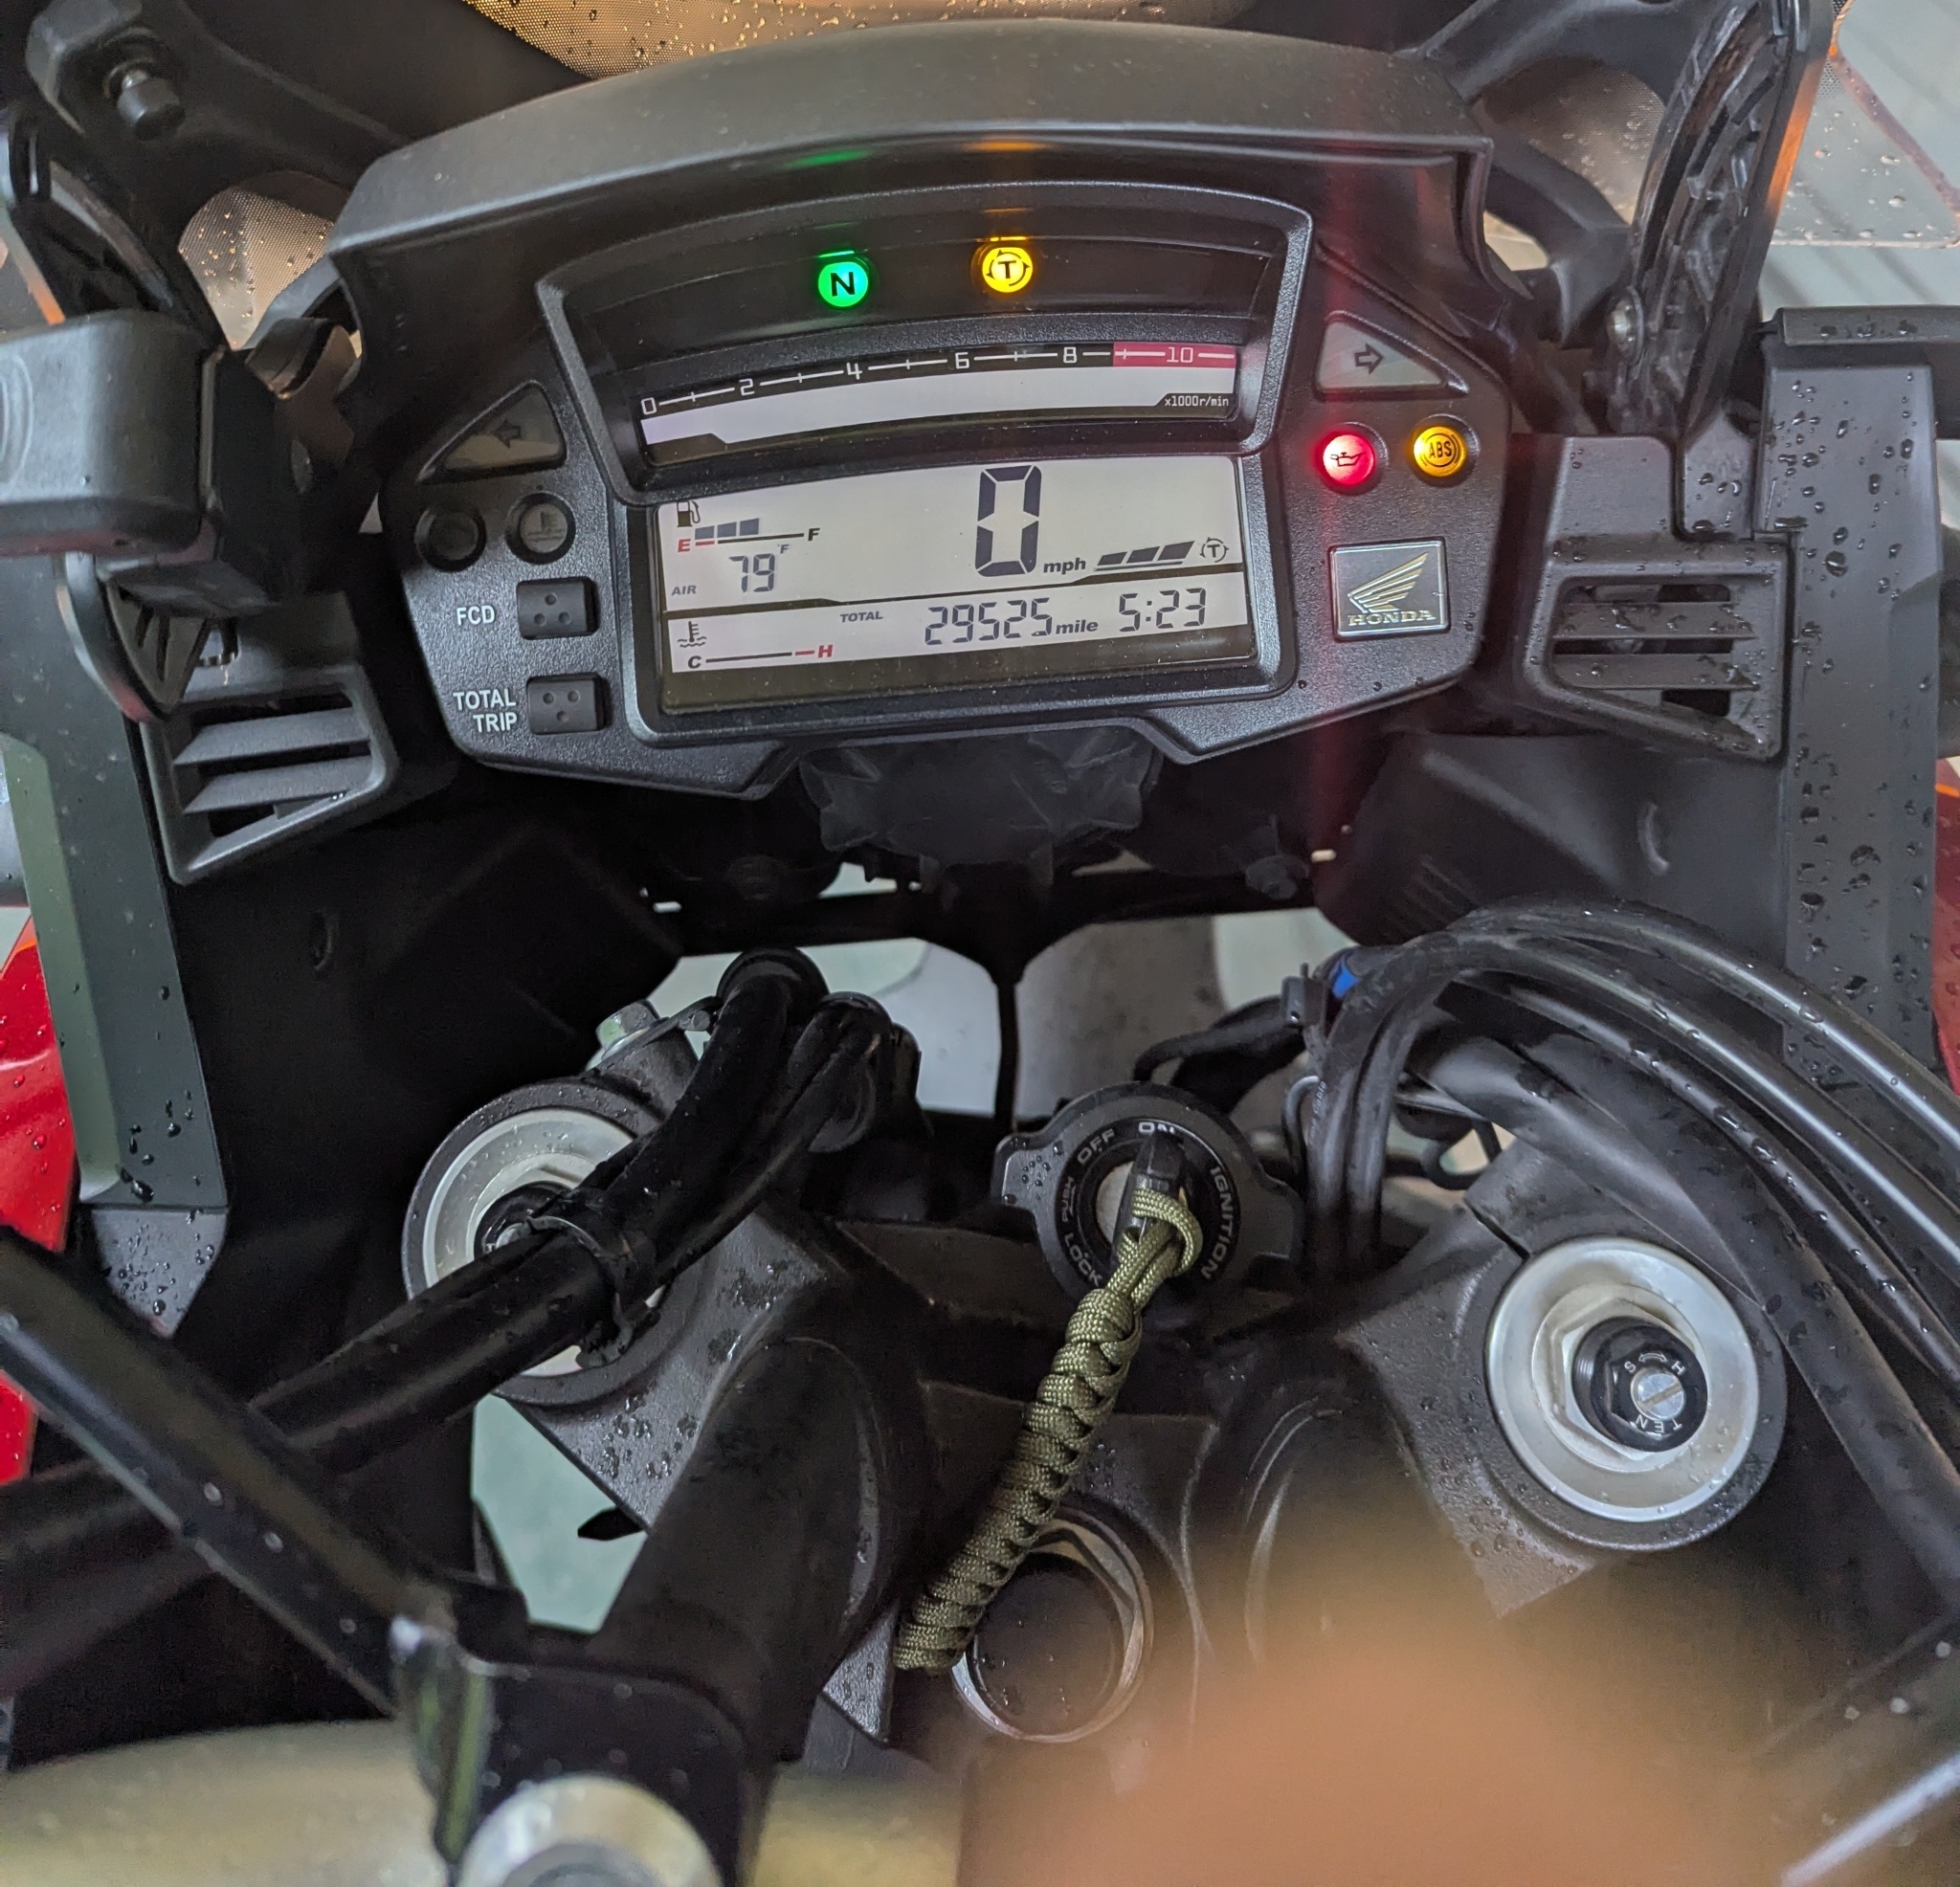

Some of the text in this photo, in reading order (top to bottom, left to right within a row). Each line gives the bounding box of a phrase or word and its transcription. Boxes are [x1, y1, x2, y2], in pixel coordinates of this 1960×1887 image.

[998, 260, 1016, 278] T
[830, 272, 856, 296] N
[640, 345, 1194, 415] 0 2 4 6 8 10
[1428, 439, 1454, 459] ABS
[974, 464, 1043, 578] 0
[678, 527, 821, 553] E F
[728, 552, 776, 593] 79
[1043, 557, 1087, 575] mph
[671, 585, 698, 596] AIR
[457, 605, 496, 626] FCD
[839, 588, 1207, 645] TOTAL 29525 mile 5:23
[1348, 610, 1437, 626] HONDA
[687, 644, 834, 670] C H
[452, 688, 517, 711] TOTAL
[473, 711, 518, 733] TRIP
[1077, 1127, 1116, 1166] OFF
[1200, 1166, 1236, 1280] IGNITION
[1063, 1232, 1103, 1288] LOCK
[1624, 1361, 1637, 1374] S
